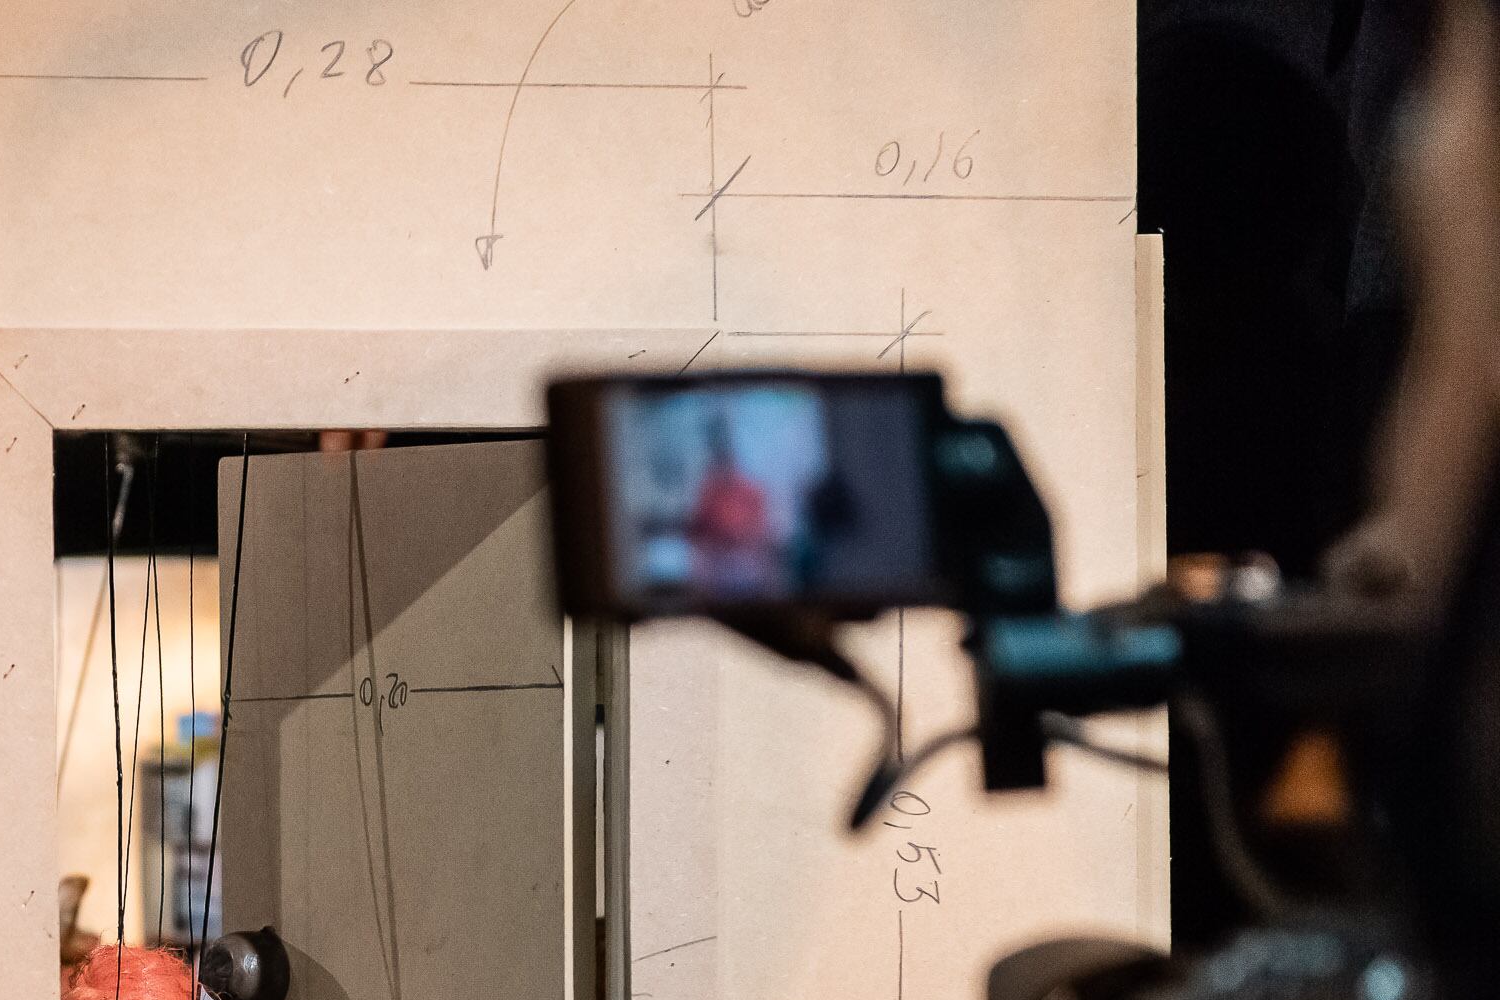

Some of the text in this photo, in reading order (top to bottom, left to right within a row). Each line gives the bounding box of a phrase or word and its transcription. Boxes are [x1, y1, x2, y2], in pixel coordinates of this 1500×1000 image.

[240, 30, 394, 98] 0,28
[875, 129, 981, 186] 0,16
[359, 672, 408, 737] 0,20
[882, 790, 942, 904] 0,53
